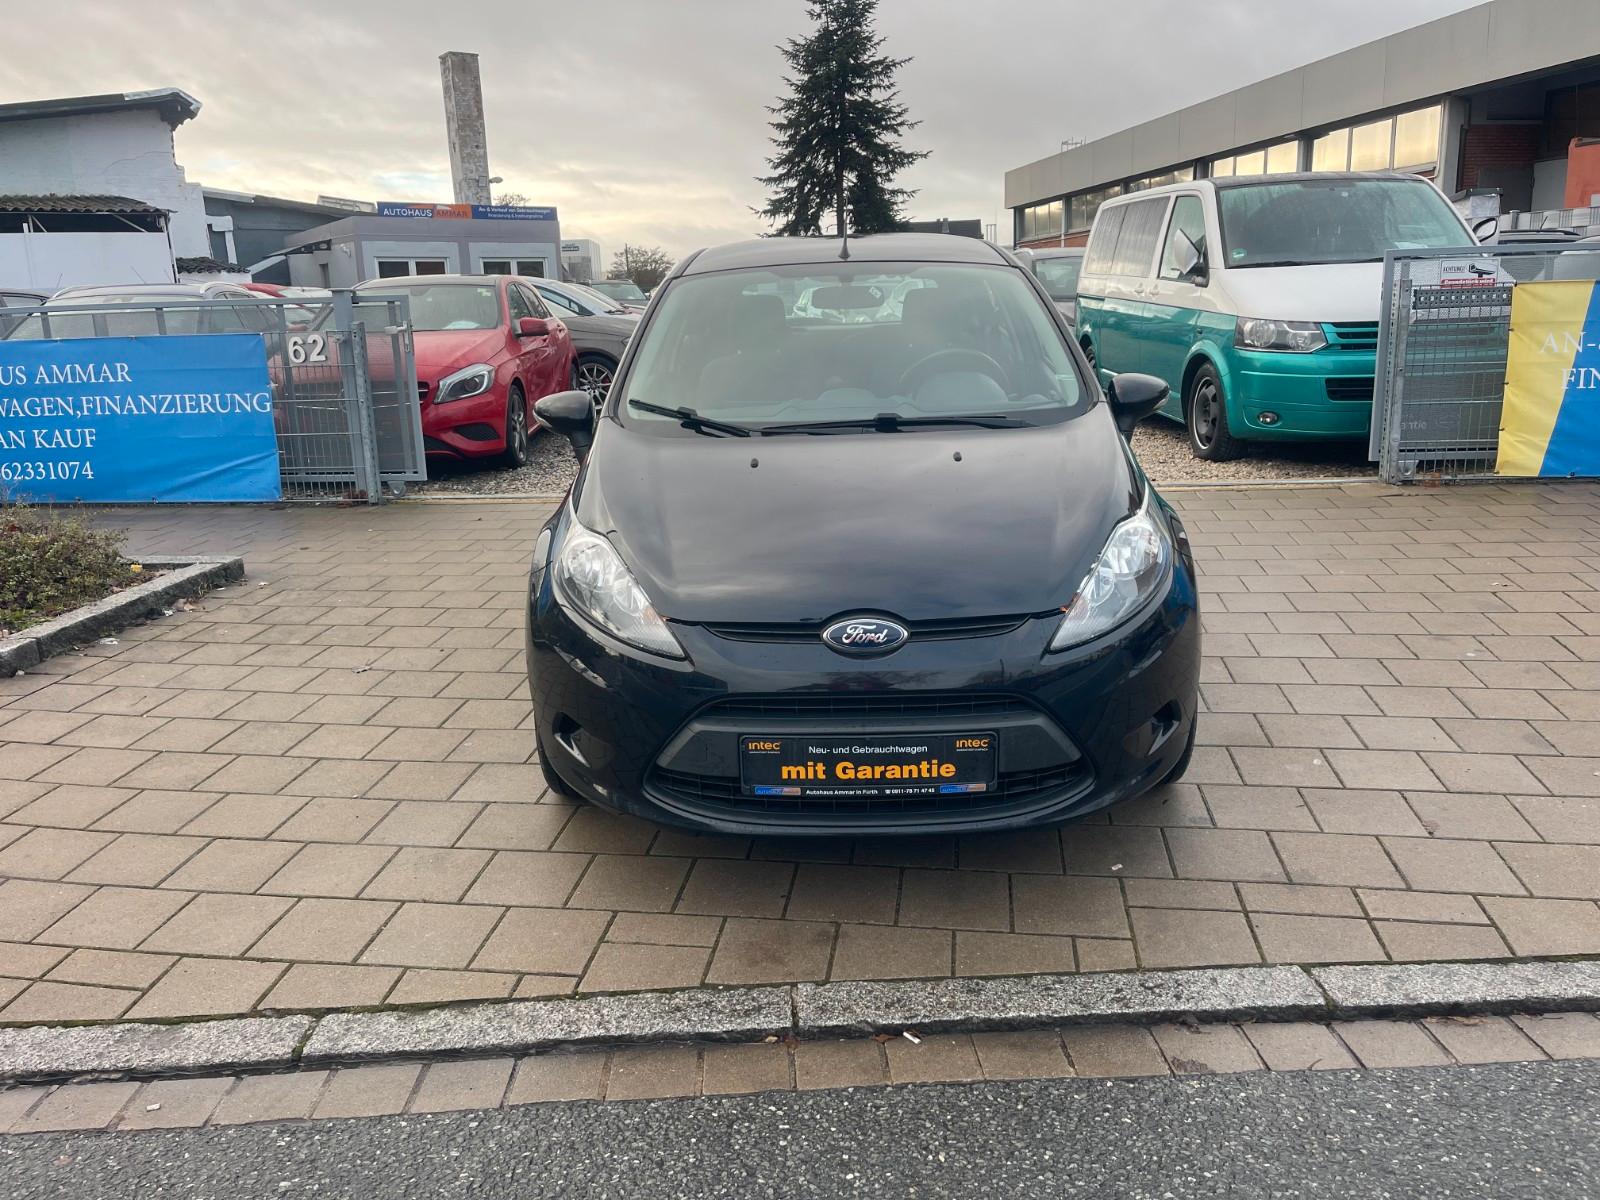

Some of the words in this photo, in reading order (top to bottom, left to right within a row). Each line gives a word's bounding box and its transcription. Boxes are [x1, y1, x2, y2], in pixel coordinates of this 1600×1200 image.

[383, 208, 432, 217] AUTOHAUS
[437, 208, 468, 217] AMMAR
[288, 334, 326, 363] 62
[1537, 331, 1600, 353] AN-
[34, 362, 133, 385] AMMAR
[32, 428, 96, 449] KAUF
[0, 460, 95, 481] 62331074
[841, 624, 888, 644] Ford
[748, 741, 781, 750] intec
[808, 745, 831, 754] Neu-
[832, 745, 850, 754] und
[851, 745, 928, 755] Gebrauchtwagen
[956, 739, 989, 748] intec
[781, 761, 826, 780] mit
[835, 759, 957, 780] Garantie
